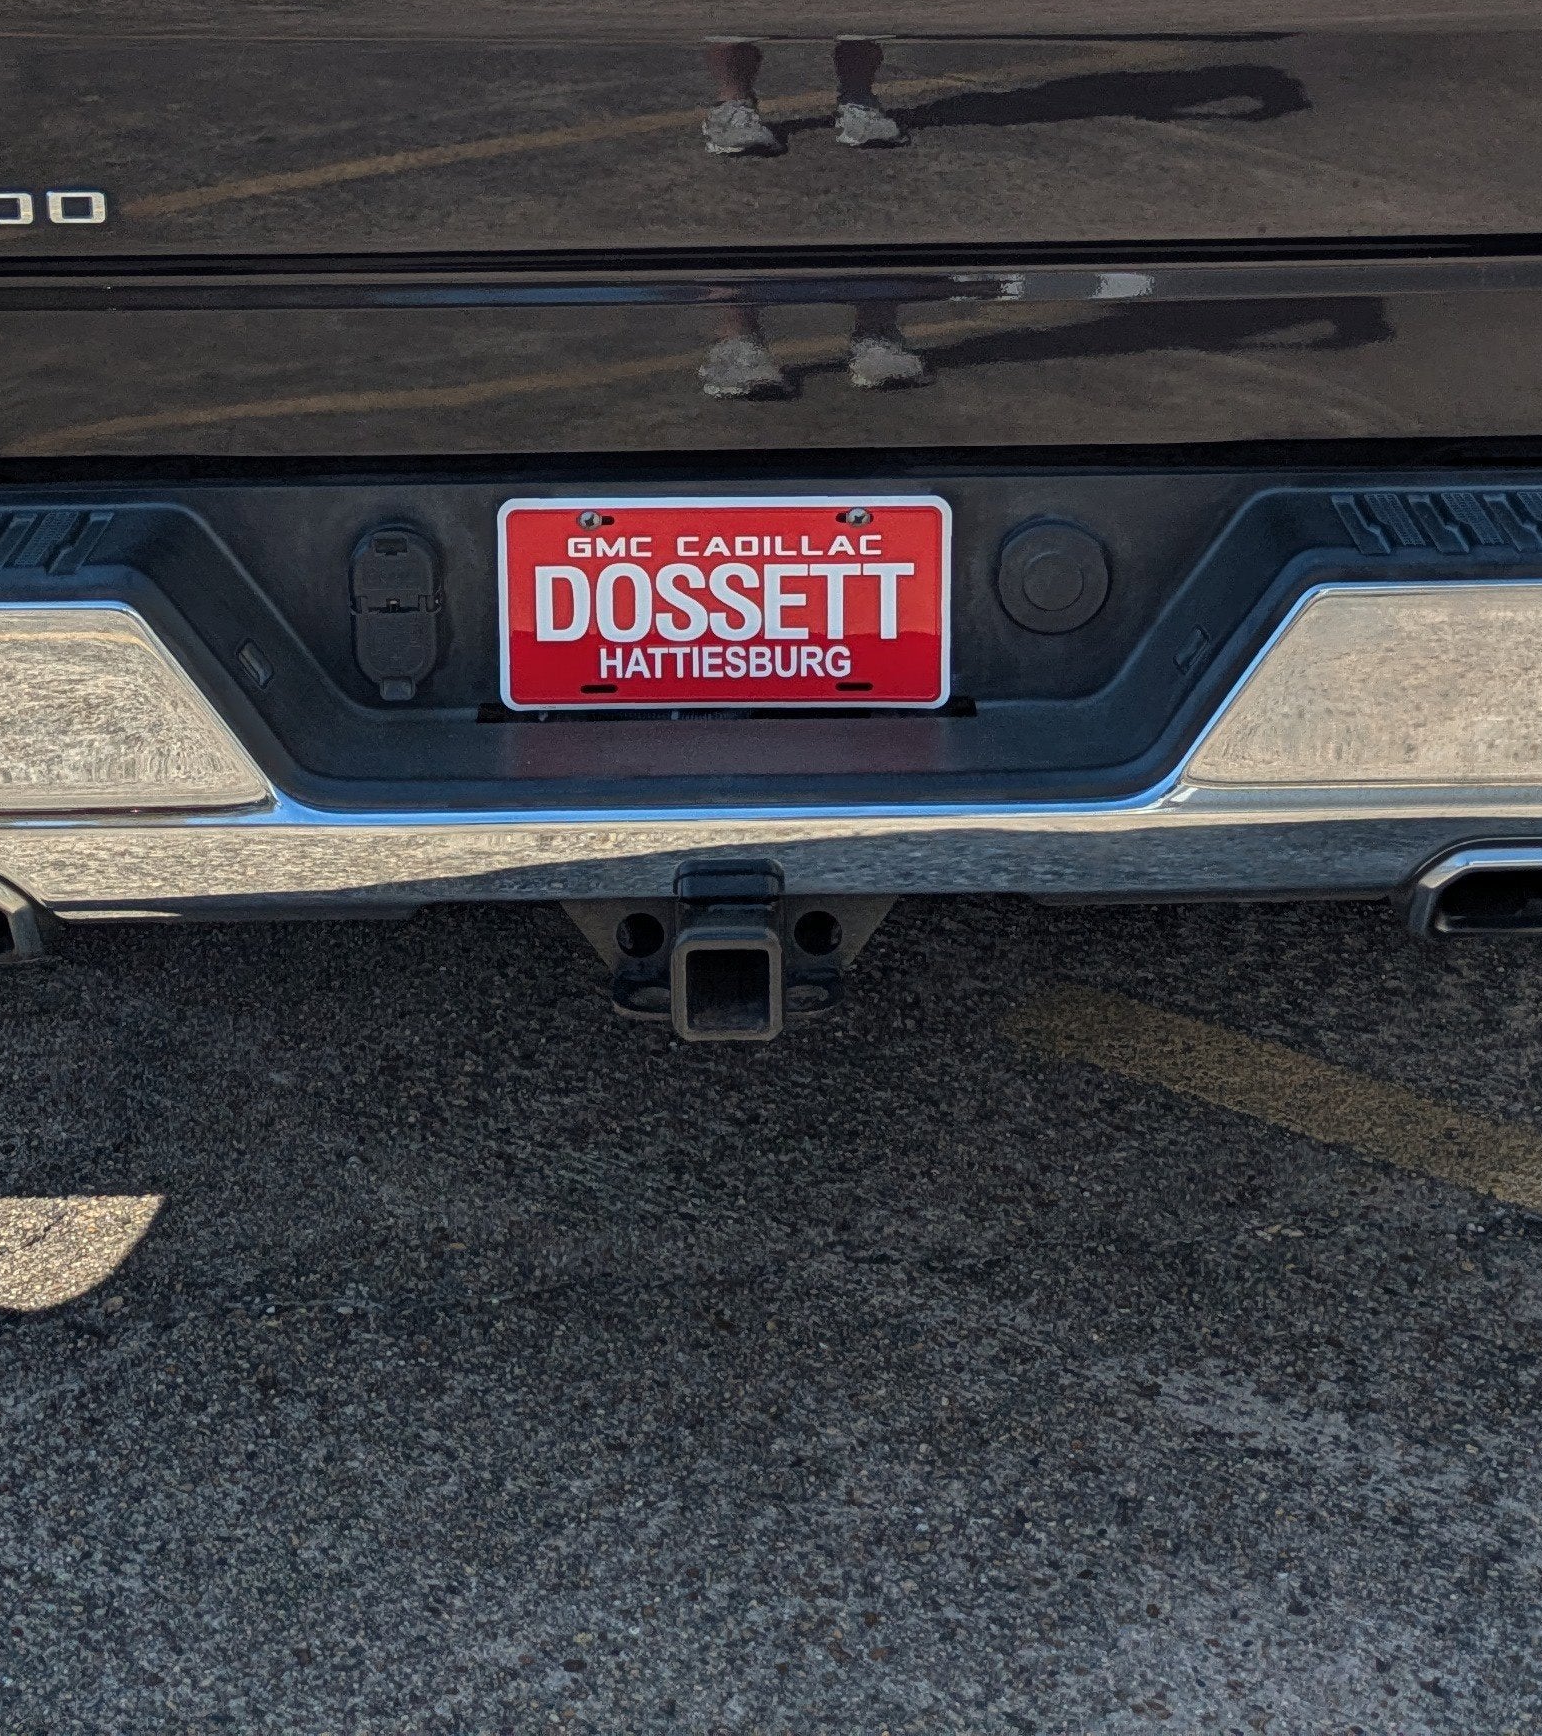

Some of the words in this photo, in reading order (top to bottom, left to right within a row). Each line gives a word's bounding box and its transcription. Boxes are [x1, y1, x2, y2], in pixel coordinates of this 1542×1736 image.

[567, 536, 653, 558] GMC
[676, 534, 883, 558] CADILLAC
[533, 561, 916, 644] DOSSETT
[598, 644, 852, 679] HATTIESBURG
